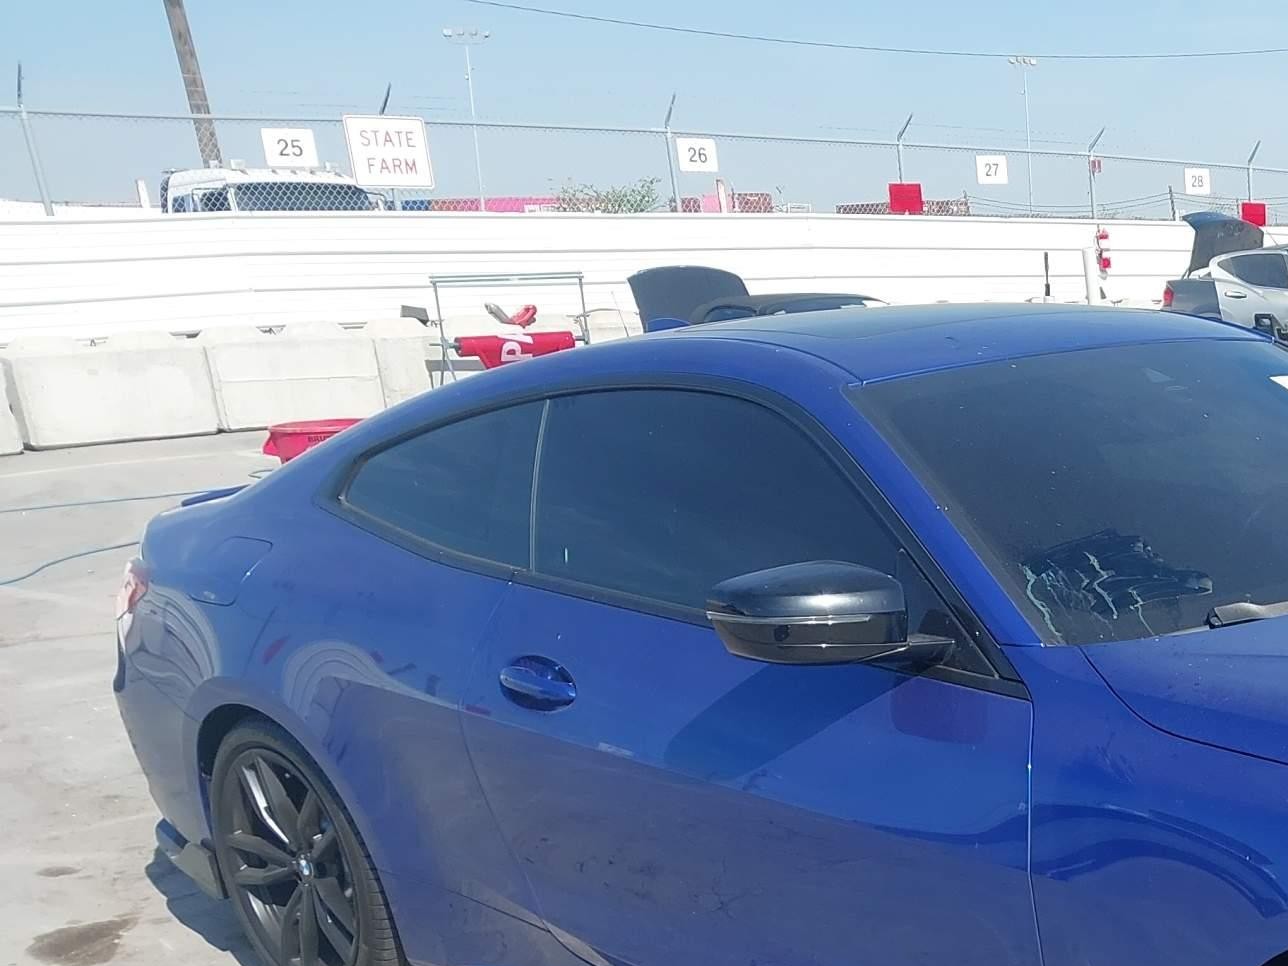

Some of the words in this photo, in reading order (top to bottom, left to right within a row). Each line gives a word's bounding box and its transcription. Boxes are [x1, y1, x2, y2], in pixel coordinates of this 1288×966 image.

[359, 129, 416, 148] STATE
[277, 138, 304, 157] 25
[687, 147, 708, 164] 26
[366, 158, 418, 175] FARM
[984, 162, 1000, 177] 27
[1191, 175, 1204, 188] 28
